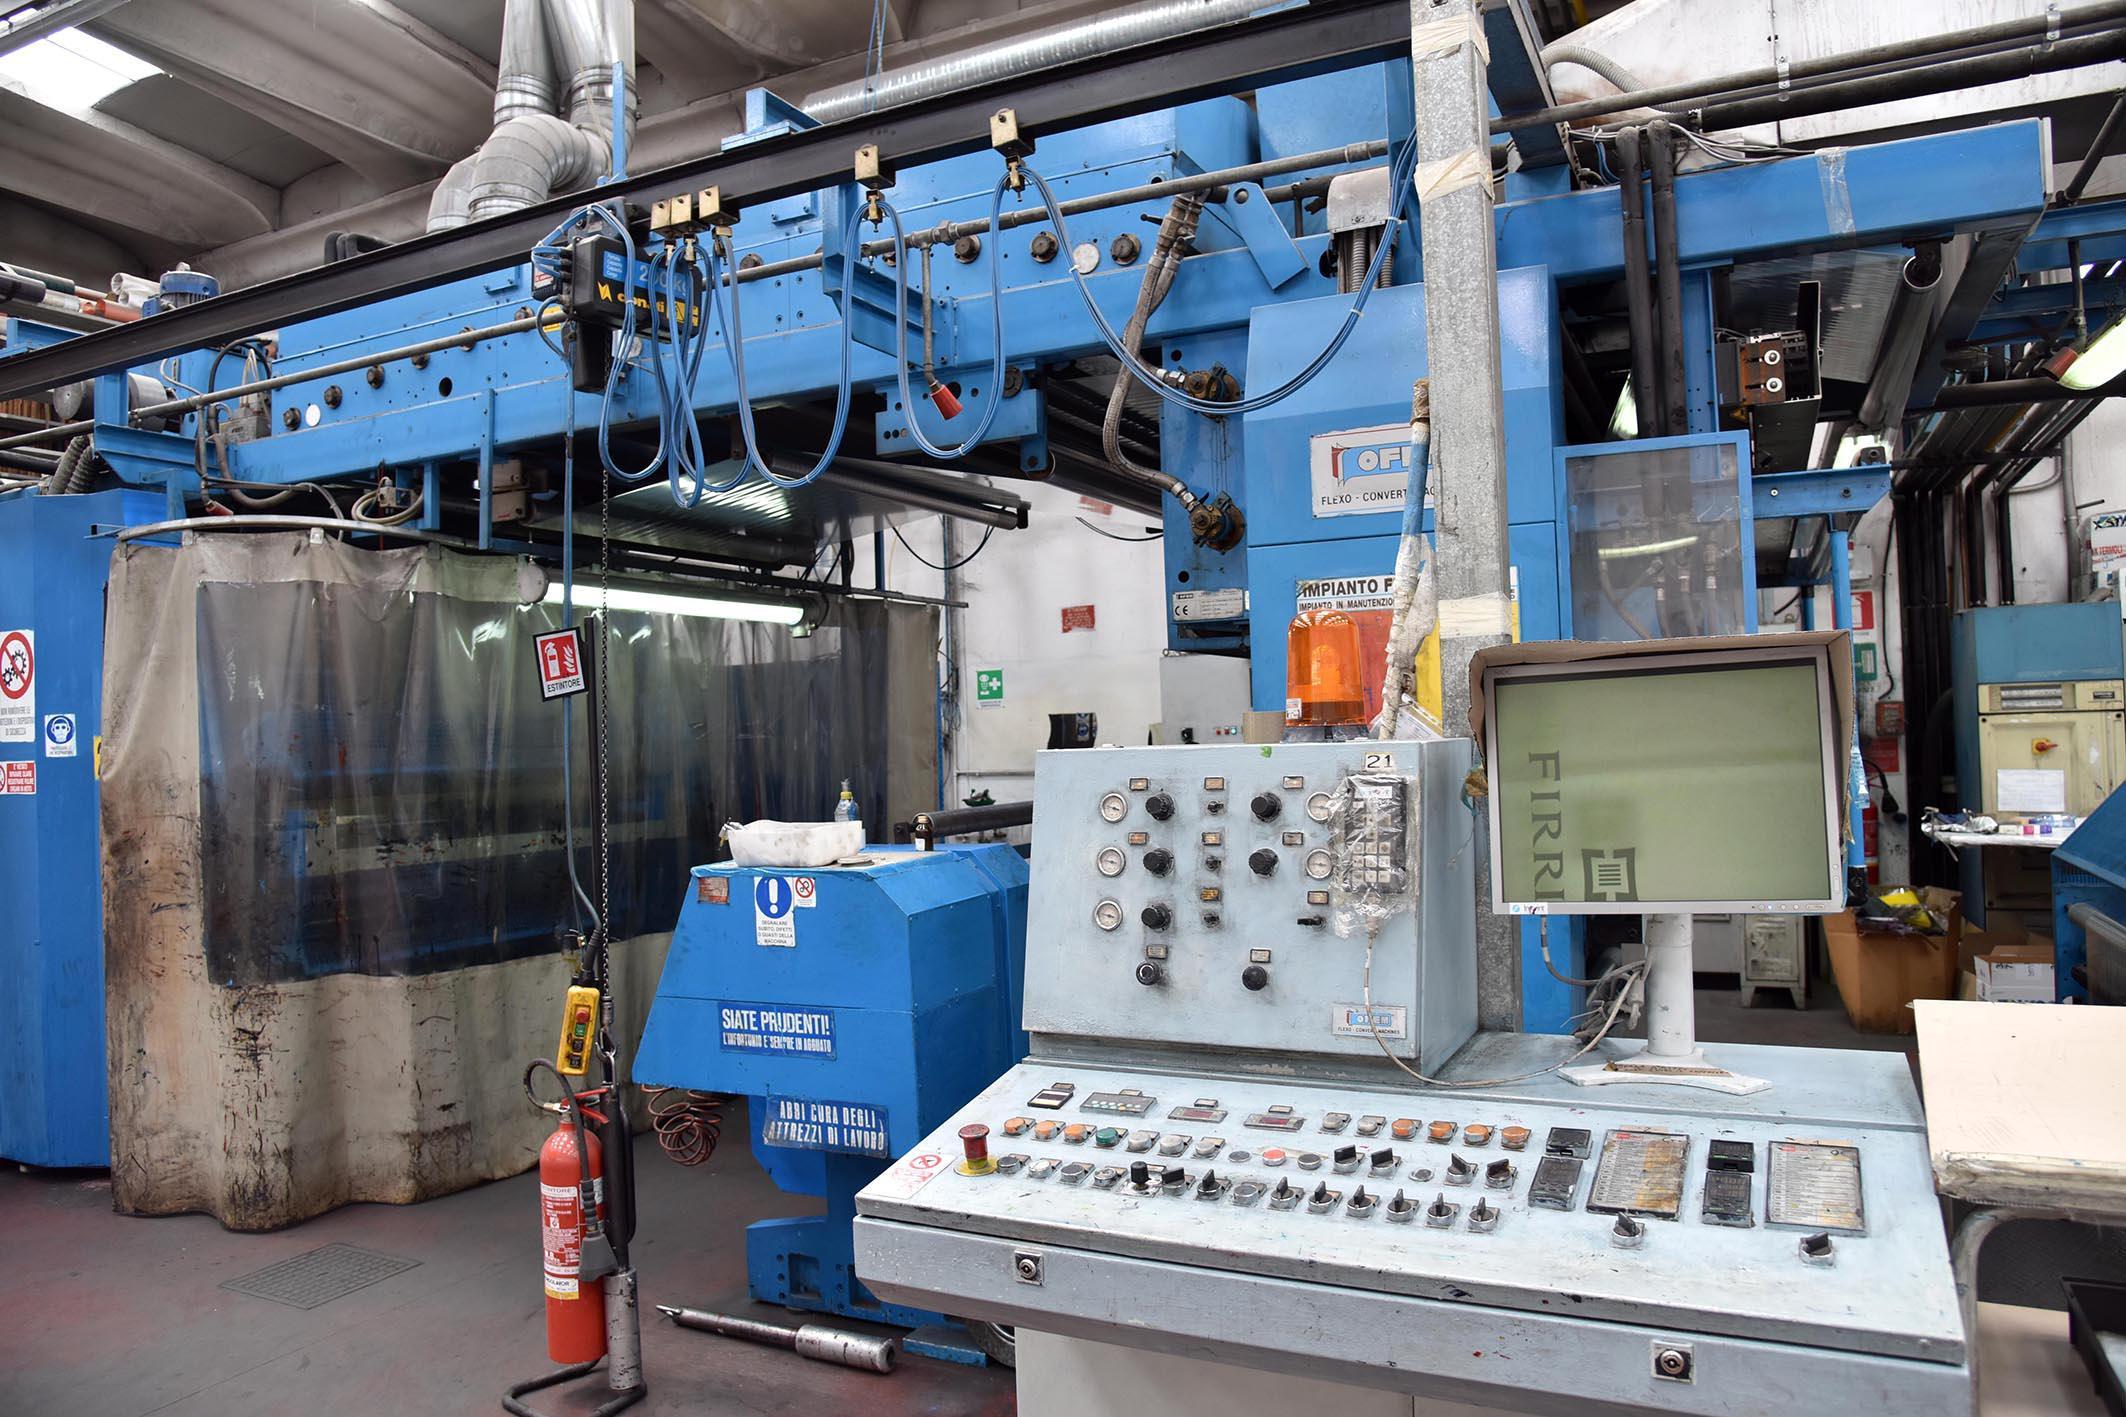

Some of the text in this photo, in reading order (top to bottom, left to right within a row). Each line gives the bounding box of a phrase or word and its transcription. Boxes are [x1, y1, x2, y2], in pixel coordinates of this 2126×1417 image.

[1321, 494, 1352, 505] FLEXO
[1302, 577, 1379, 598] IMPIANTO
[1336, 600, 1344, 609] IN
[1347, 597, 1394, 608] MANUTENZIO
[546, 678, 582, 693] ESTINTORE
[1367, 754, 1392, 768] 21
[722, 1008, 830, 1035] SIATE PRUDENTI!
[803, 1037, 832, 1053] AGGUATO
[779, 1100, 876, 1129] ABBI CURA DEGLI
[768, 1121, 884, 1151] ATTREZZI DI LAVORO
